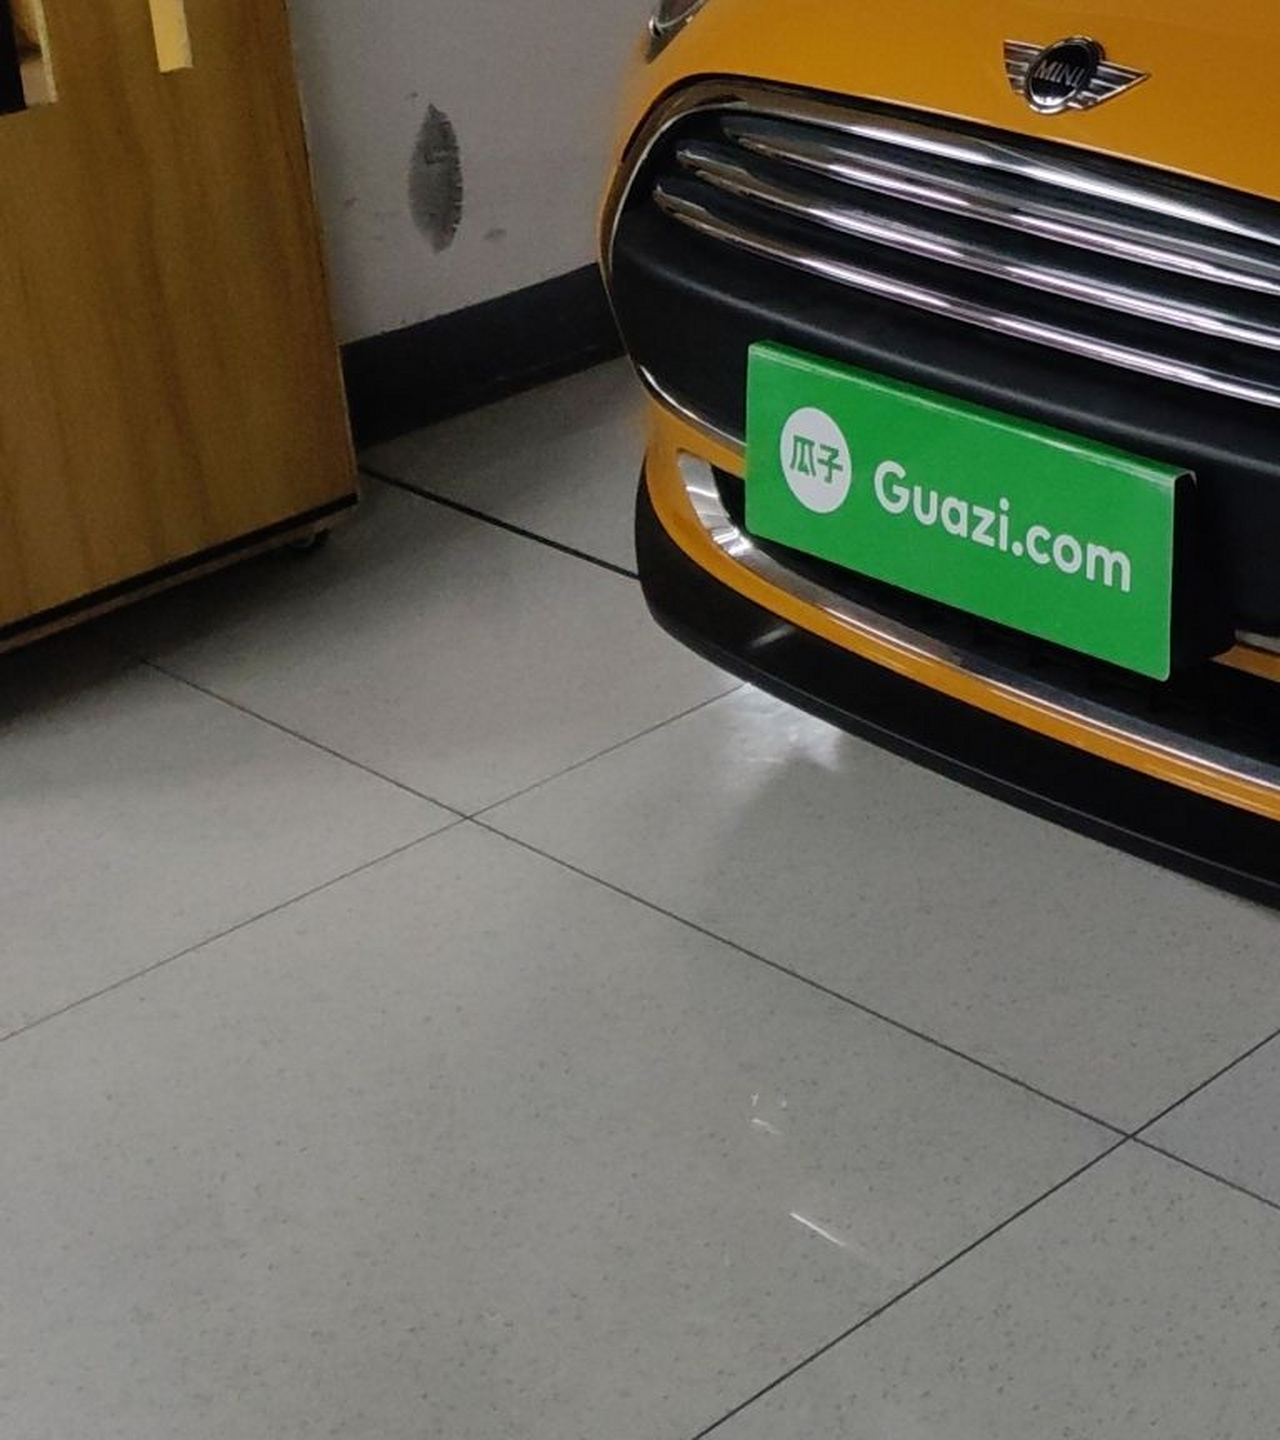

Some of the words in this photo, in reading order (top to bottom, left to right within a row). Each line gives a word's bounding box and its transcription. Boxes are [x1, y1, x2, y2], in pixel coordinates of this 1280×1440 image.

[1034, 60, 1085, 88] MINI
[788, 433, 844, 484] 瓜子
[873, 460, 1131, 593] Guazi.com
